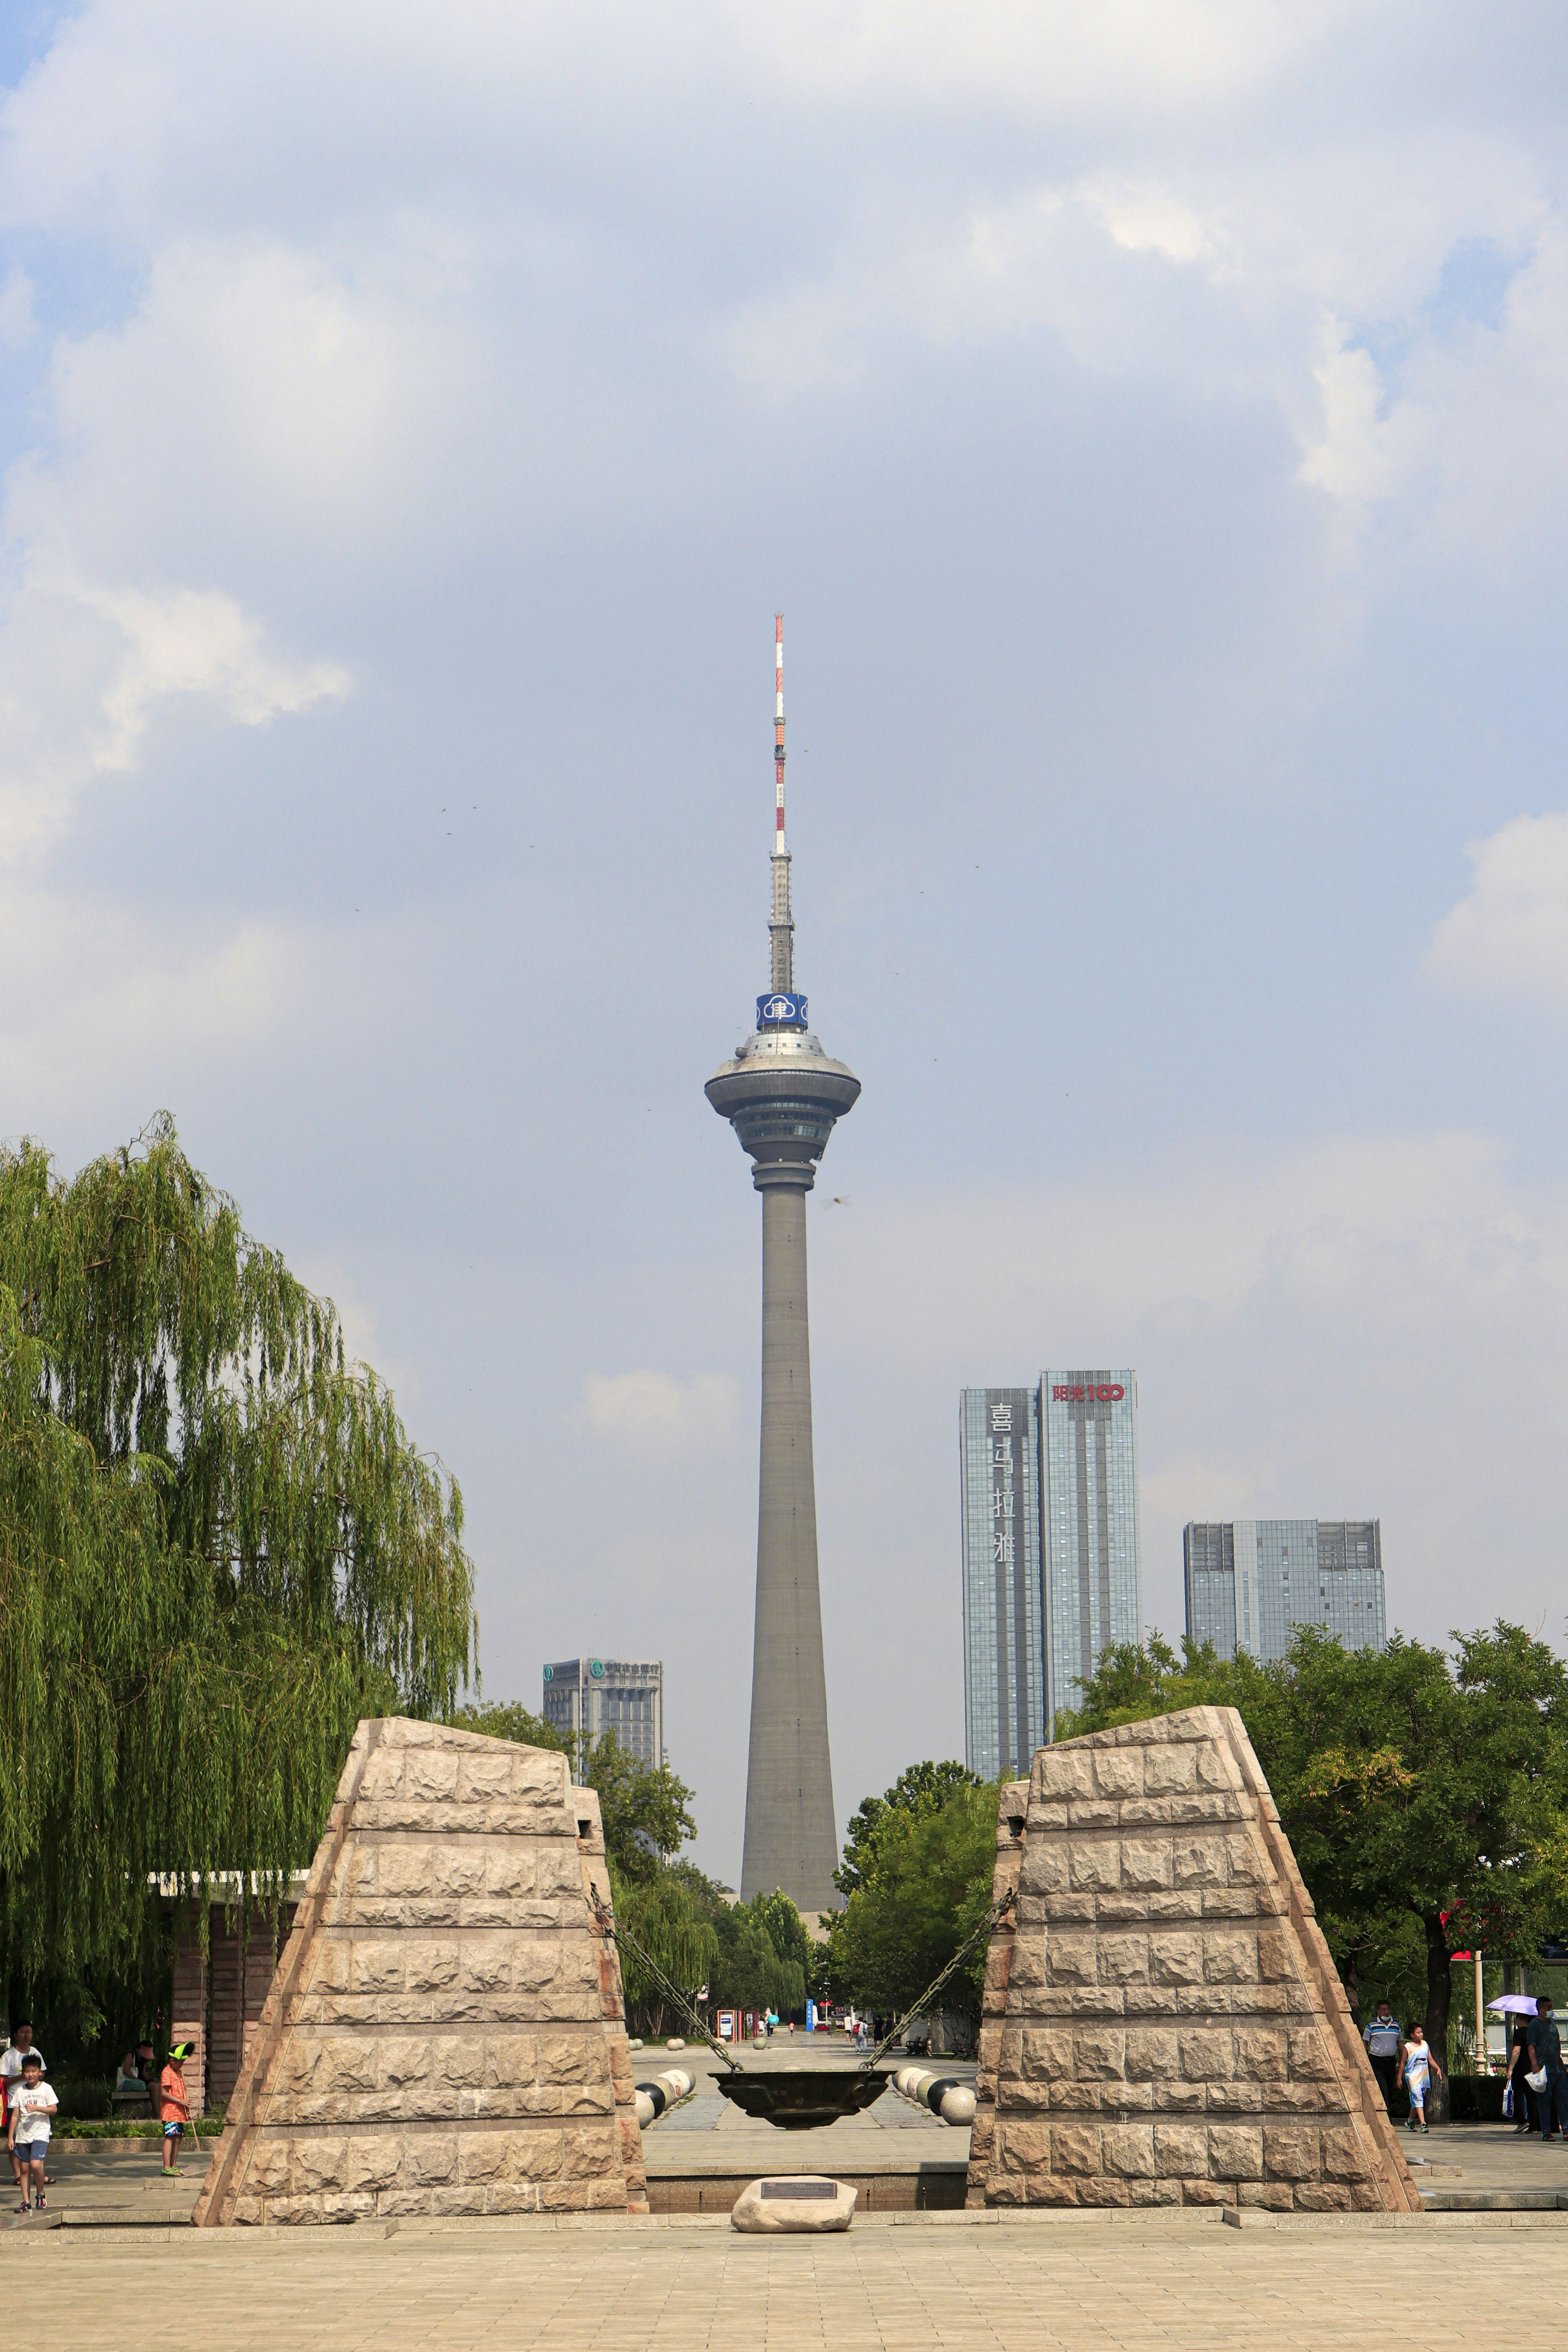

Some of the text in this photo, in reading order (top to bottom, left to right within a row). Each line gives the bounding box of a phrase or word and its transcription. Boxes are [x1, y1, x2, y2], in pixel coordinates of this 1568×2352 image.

[1052, 1384, 1125, 1401] 阳光100
[990, 1403, 1015, 1562] 喜马拉雅
